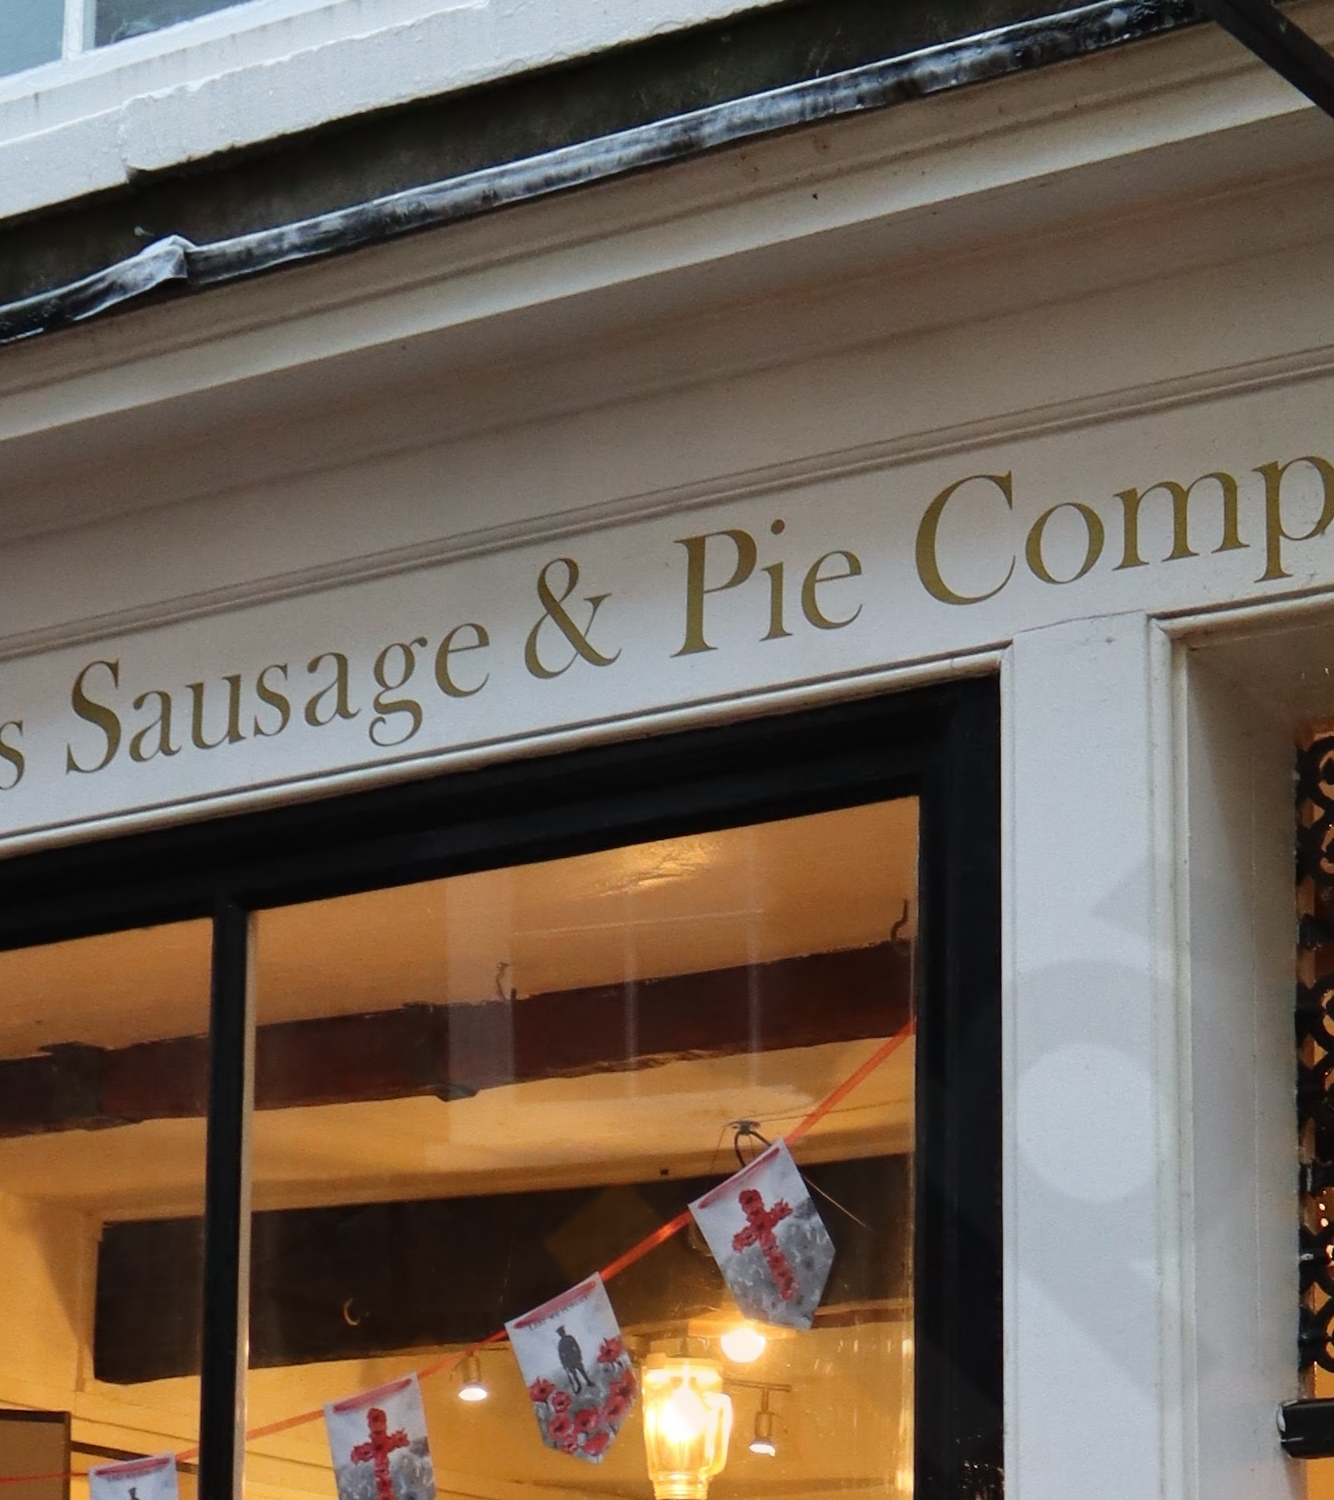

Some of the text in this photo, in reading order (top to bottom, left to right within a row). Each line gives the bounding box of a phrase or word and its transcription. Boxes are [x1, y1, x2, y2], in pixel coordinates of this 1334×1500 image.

[64, 614, 495, 784] Sausage
[521, 556, 621, 683] &
[672, 517, 865, 661] Pie
